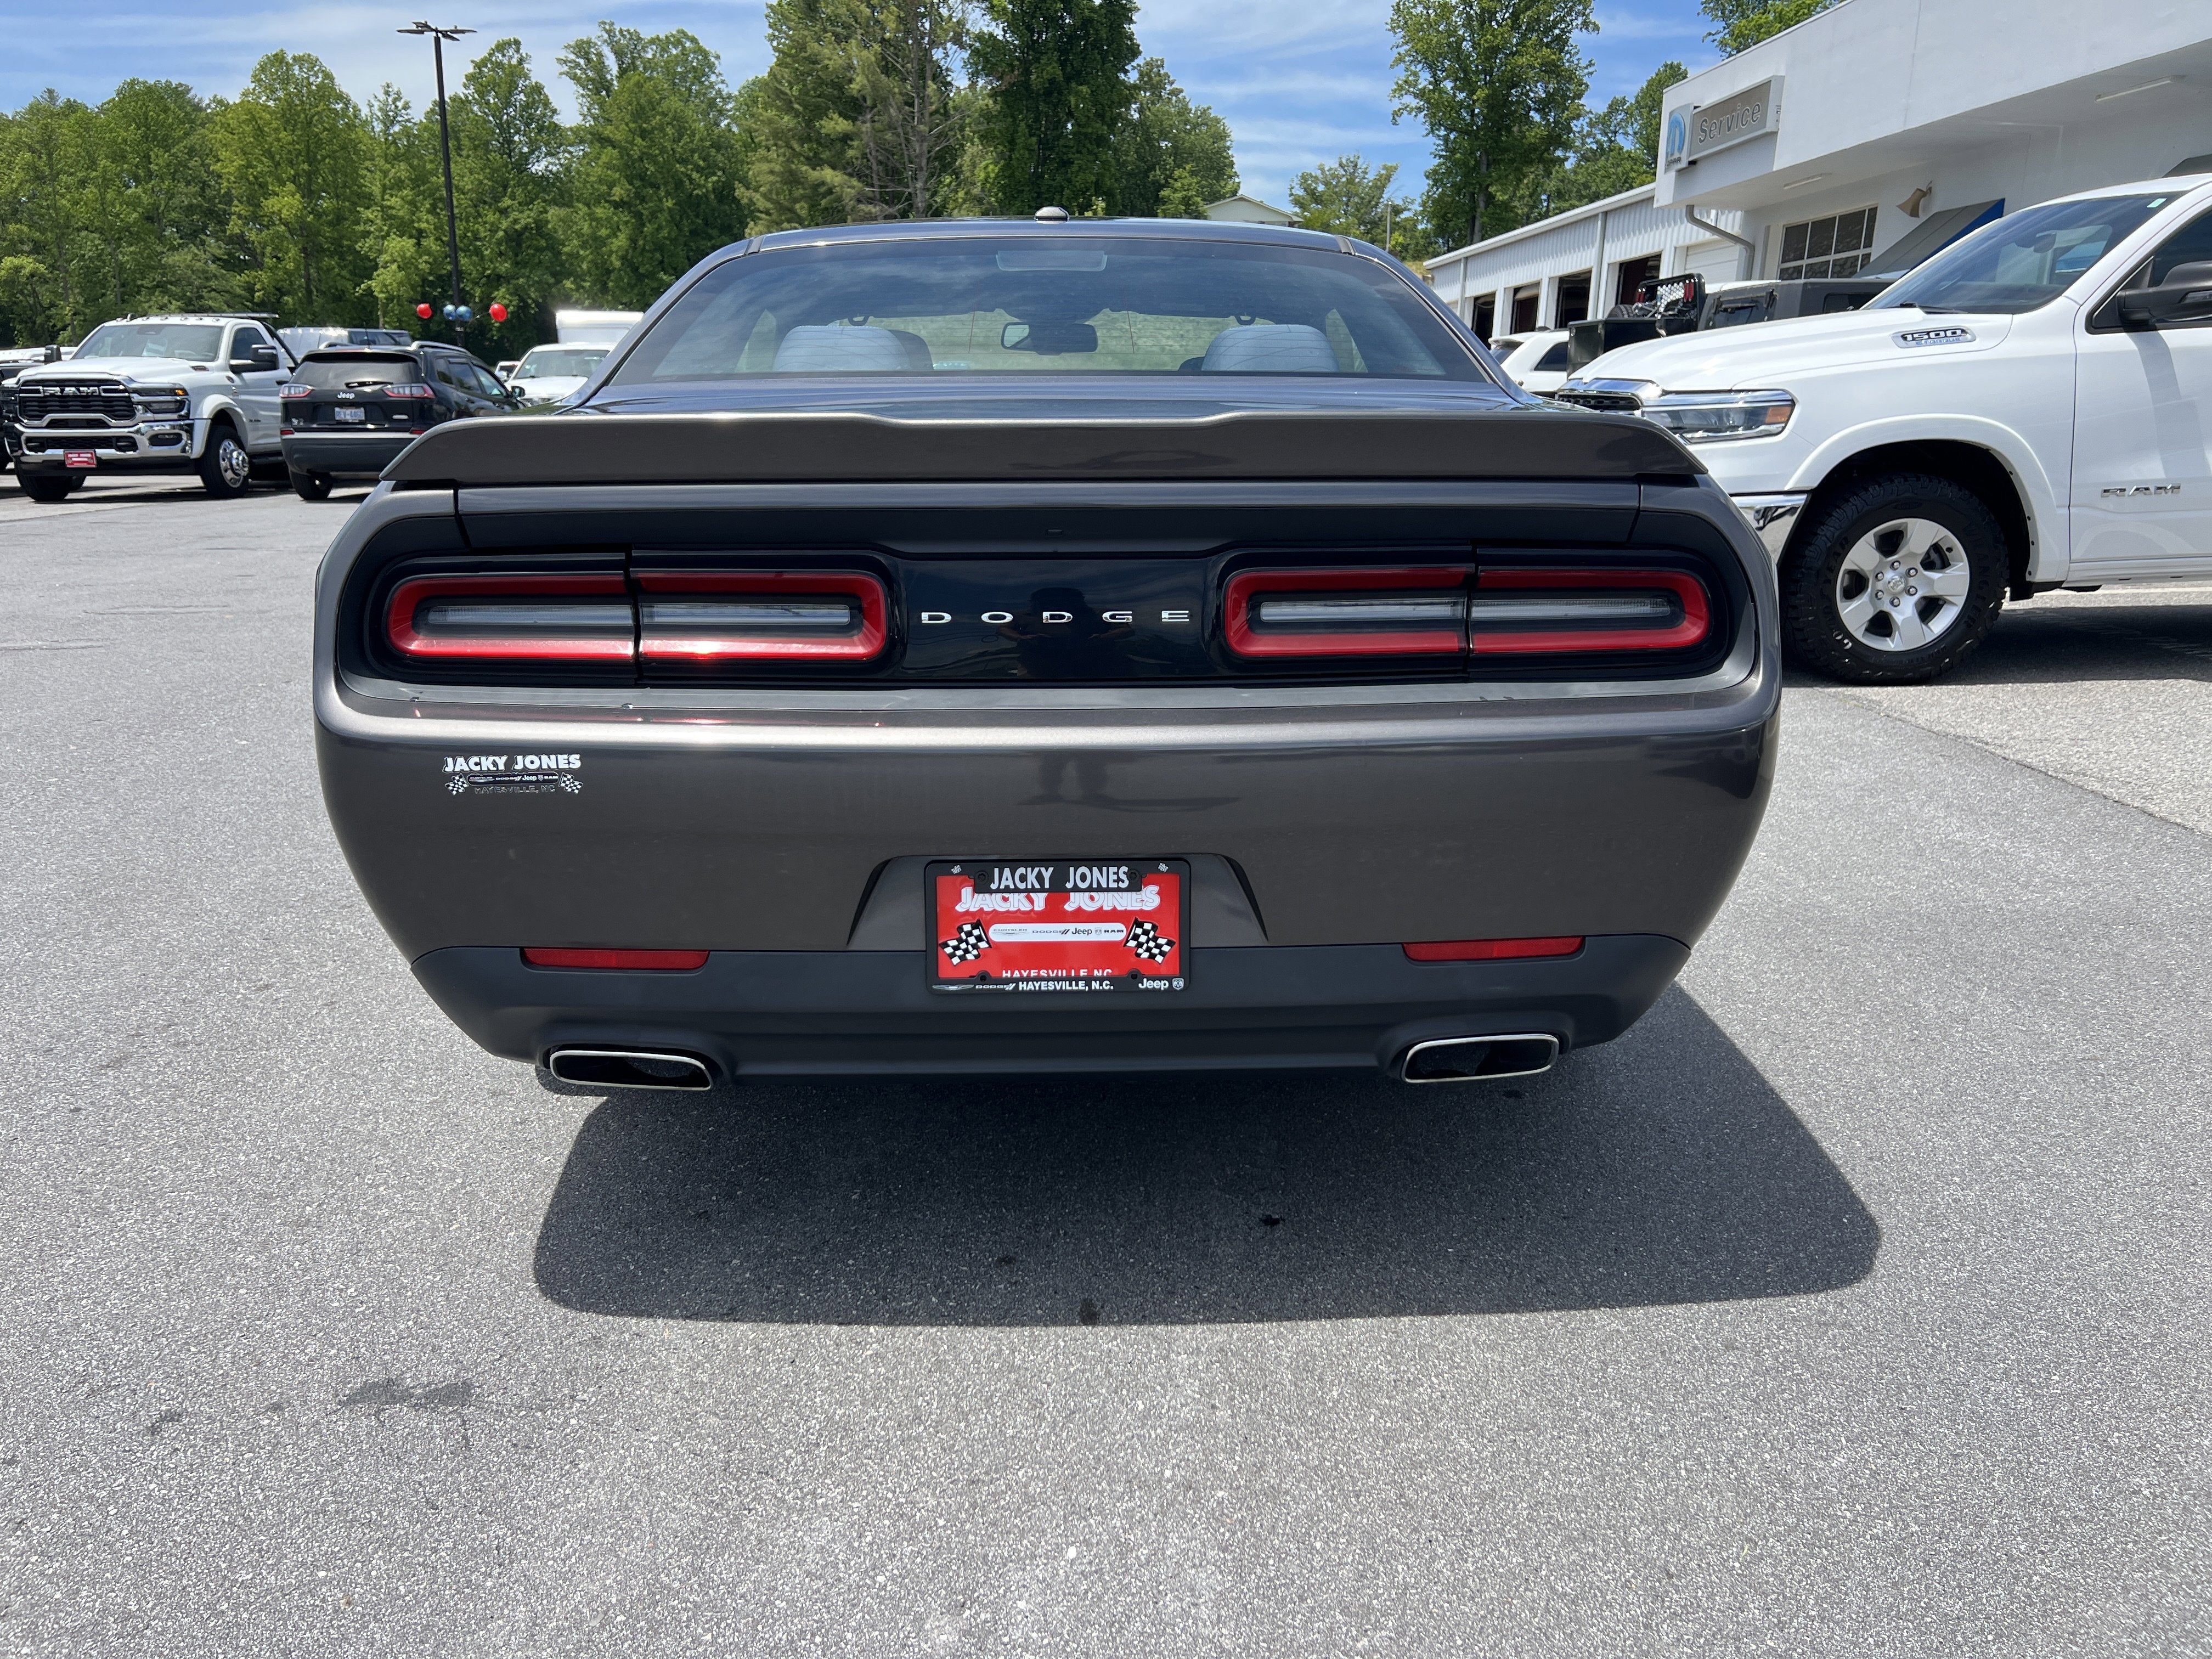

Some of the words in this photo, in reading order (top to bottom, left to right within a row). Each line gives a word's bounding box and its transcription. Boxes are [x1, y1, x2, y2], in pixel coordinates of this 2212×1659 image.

[1698, 103, 1762, 145] Service
[1904, 329, 1962, 341] 1500
[43, 387, 100, 396] RAM
[337, 391, 355, 399] Jeep
[2101, 483, 2181, 498] RAM
[921, 611, 1189, 624] DODGE
[442, 755, 508, 773] JACKY
[512, 754, 581, 770] JONES
[990, 867, 1054, 890] JACKY
[1065, 866, 1130, 889] JONES
[955, 887, 1049, 912] JACKY
[1063, 885, 1161, 911] JONES
[1071, 928, 1092, 936] Jeep
[1019, 981, 1088, 991] HAYESVILLE,
[1092, 980, 1114, 990] N.C.
[1138, 978, 1169, 990] Jeep
